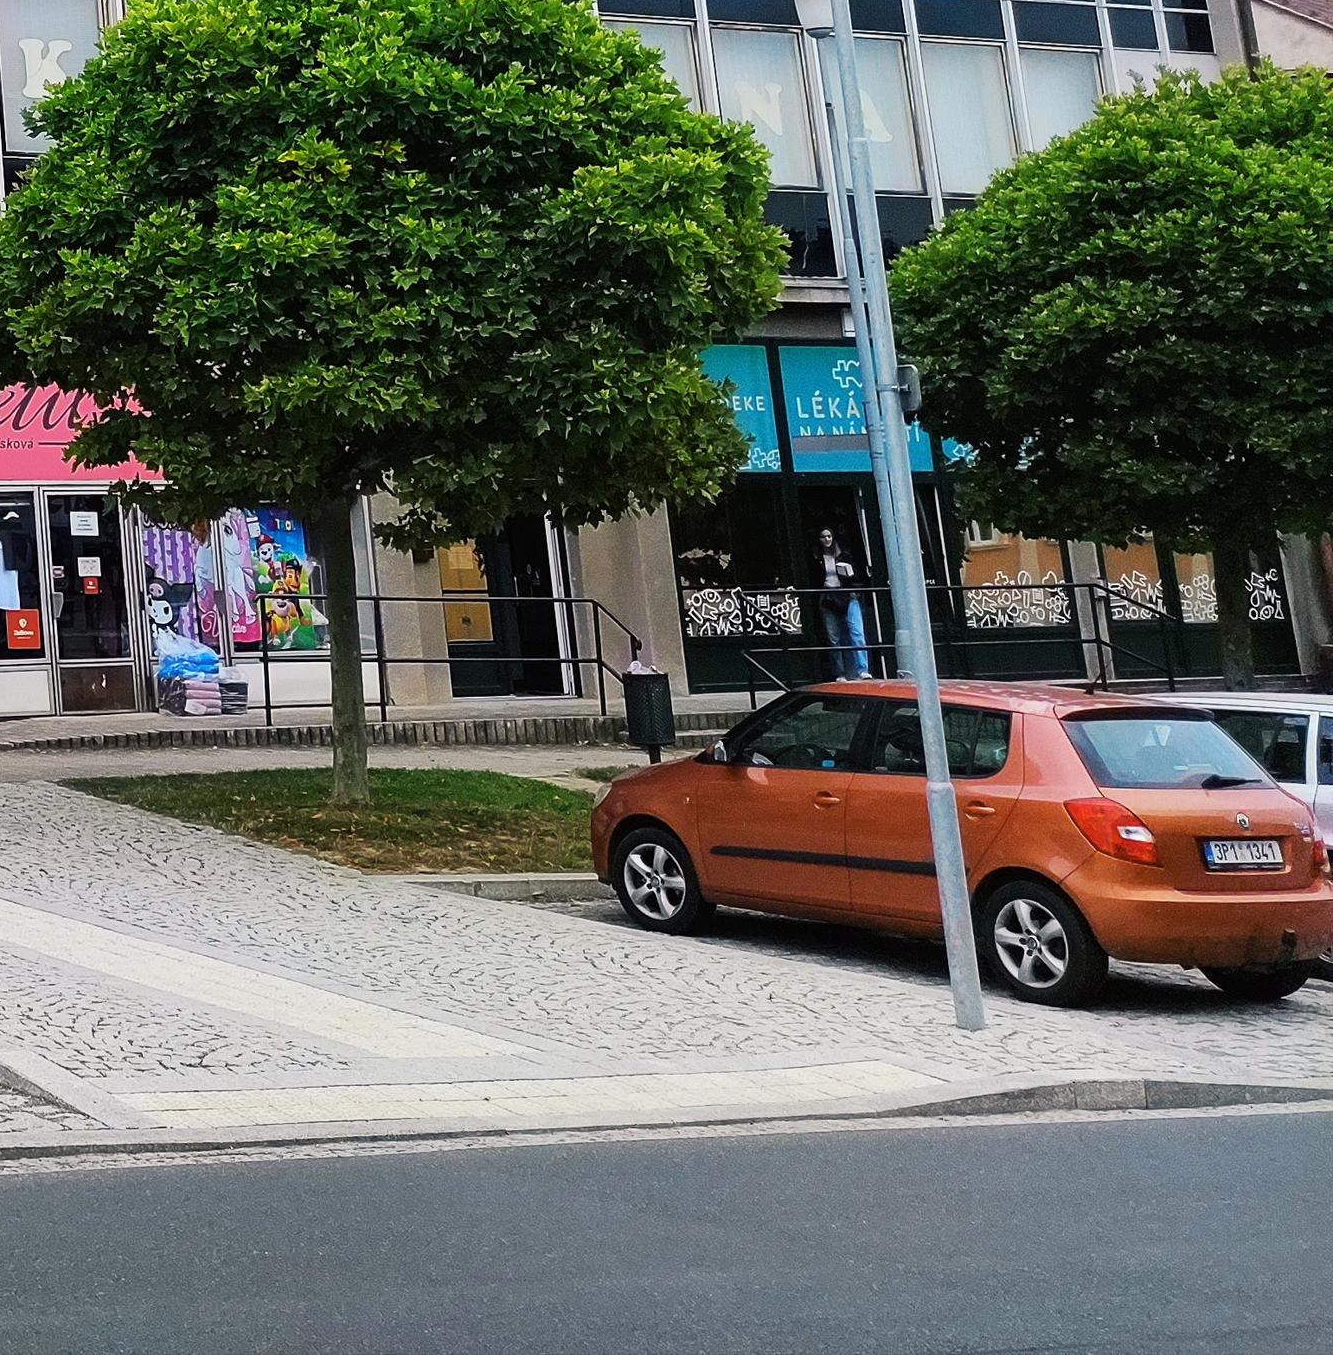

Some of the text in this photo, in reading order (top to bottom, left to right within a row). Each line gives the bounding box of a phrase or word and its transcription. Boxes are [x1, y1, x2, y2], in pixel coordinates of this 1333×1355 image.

[796, 390, 862, 419] LÉKÁ
[1214, 842, 1276, 861] 3P1 1341
